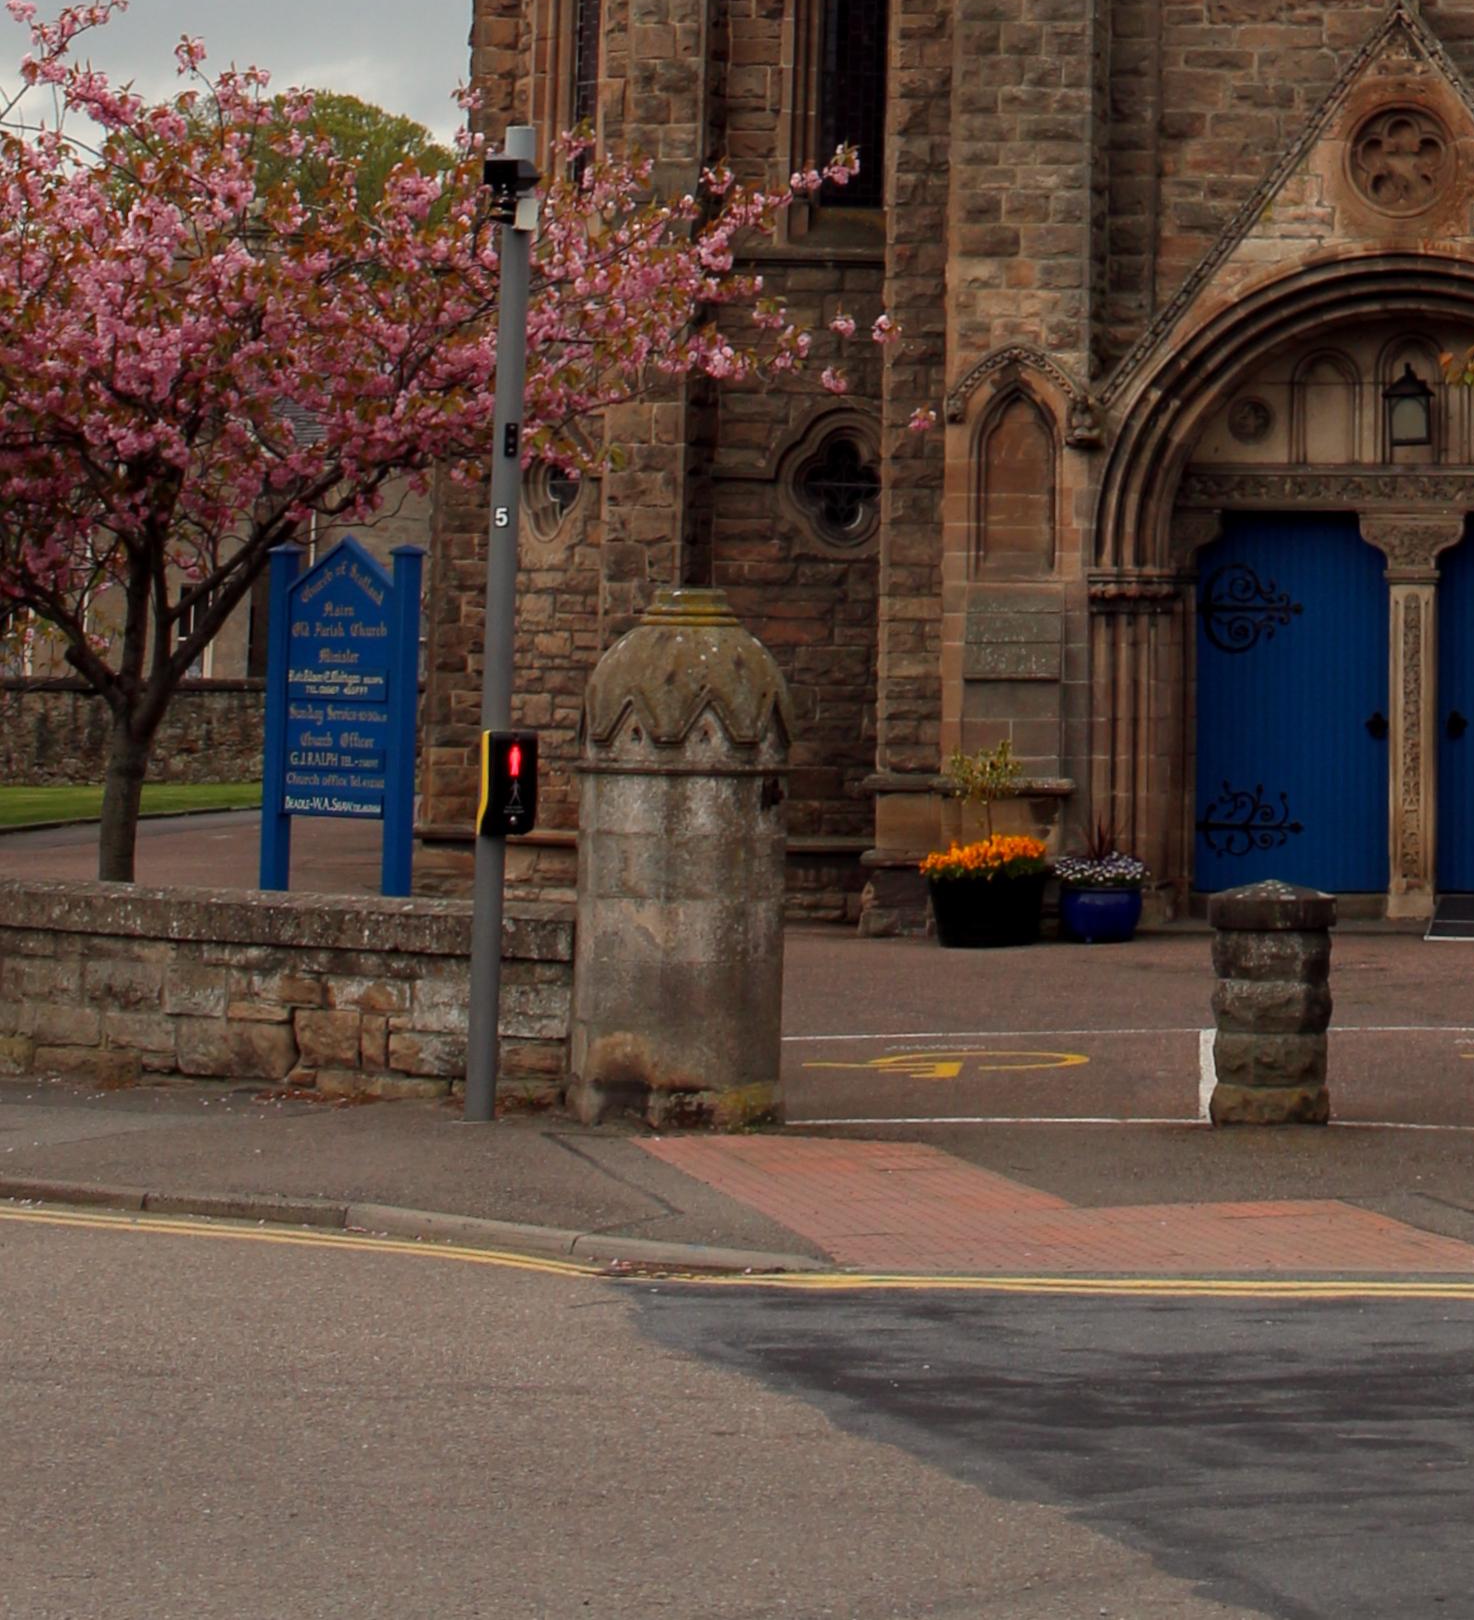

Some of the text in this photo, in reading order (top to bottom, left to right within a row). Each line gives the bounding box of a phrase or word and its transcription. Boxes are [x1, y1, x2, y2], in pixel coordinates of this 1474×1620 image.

[495, 507, 509, 527] 5
[301, 568, 333, 603] Church
[335, 560, 348, 576] of
[313, 621, 345, 637] Parish
[350, 620, 388, 638] Church
[318, 647, 360, 664] Minister
[289, 703, 324, 726] Sunday
[301, 730, 375, 749] Church Officer
[286, 771, 320, 785] Church
[321, 773, 347, 787] office
